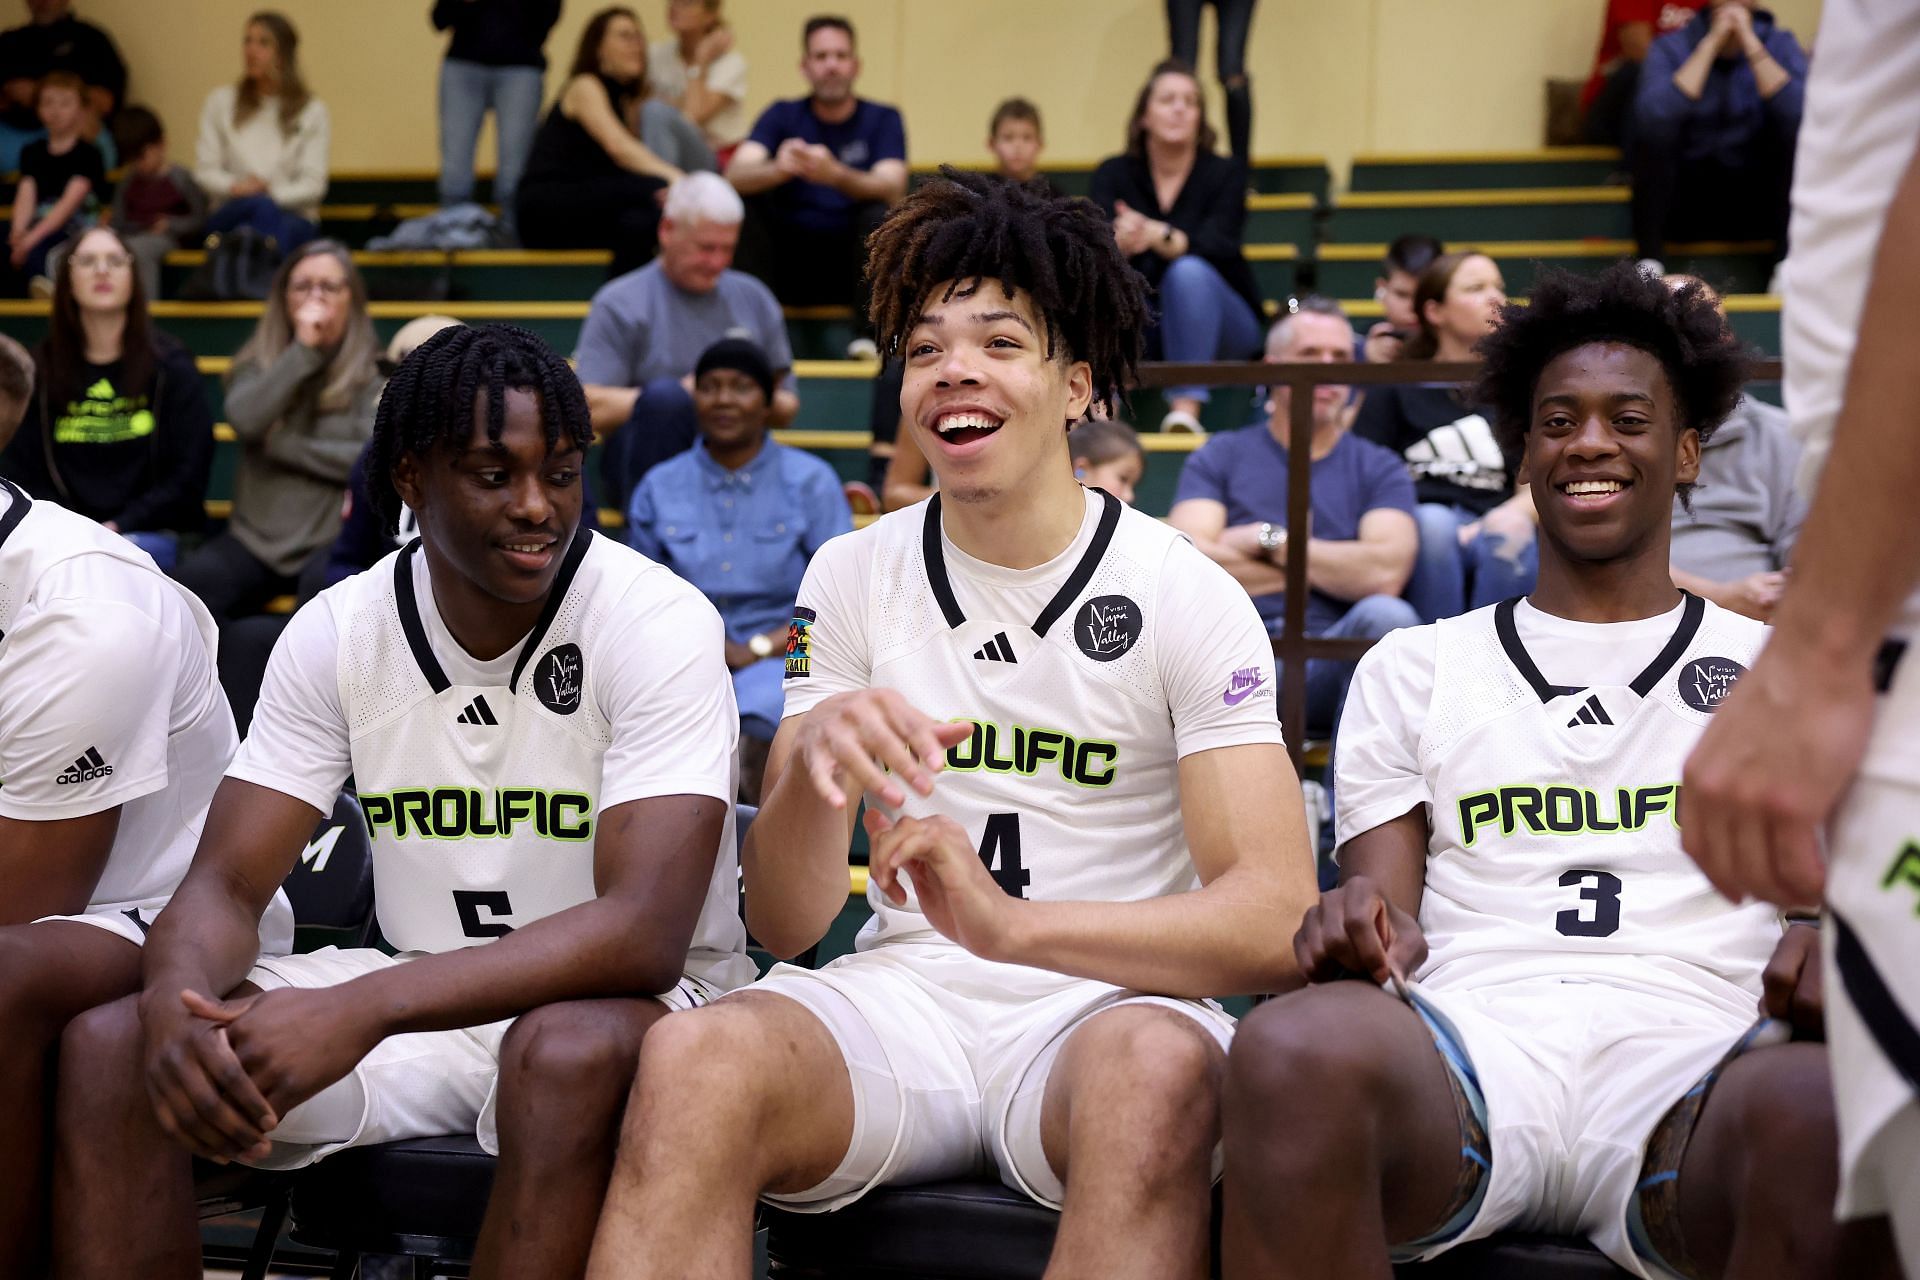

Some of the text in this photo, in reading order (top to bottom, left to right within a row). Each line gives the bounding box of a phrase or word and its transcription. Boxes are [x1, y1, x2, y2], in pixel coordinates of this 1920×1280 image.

[1090, 603, 1129, 628] Napa
[1086, 626, 1133, 653] Valley
[550, 653, 578, 679] Napa
[1231, 667, 1261, 690] NIKE
[1694, 664, 1738, 687] Napa
[548, 677, 581, 705] Valley
[1692, 683, 1731, 705] Valle
[941, 717, 1119, 789] OLIFIC
[56, 765, 113, 785] adidas
[358, 785, 593, 842] PROLIFIC
[1457, 782, 1684, 848] PROLIF
[978, 812, 1031, 901] 4
[1555, 869, 1622, 938] 3
